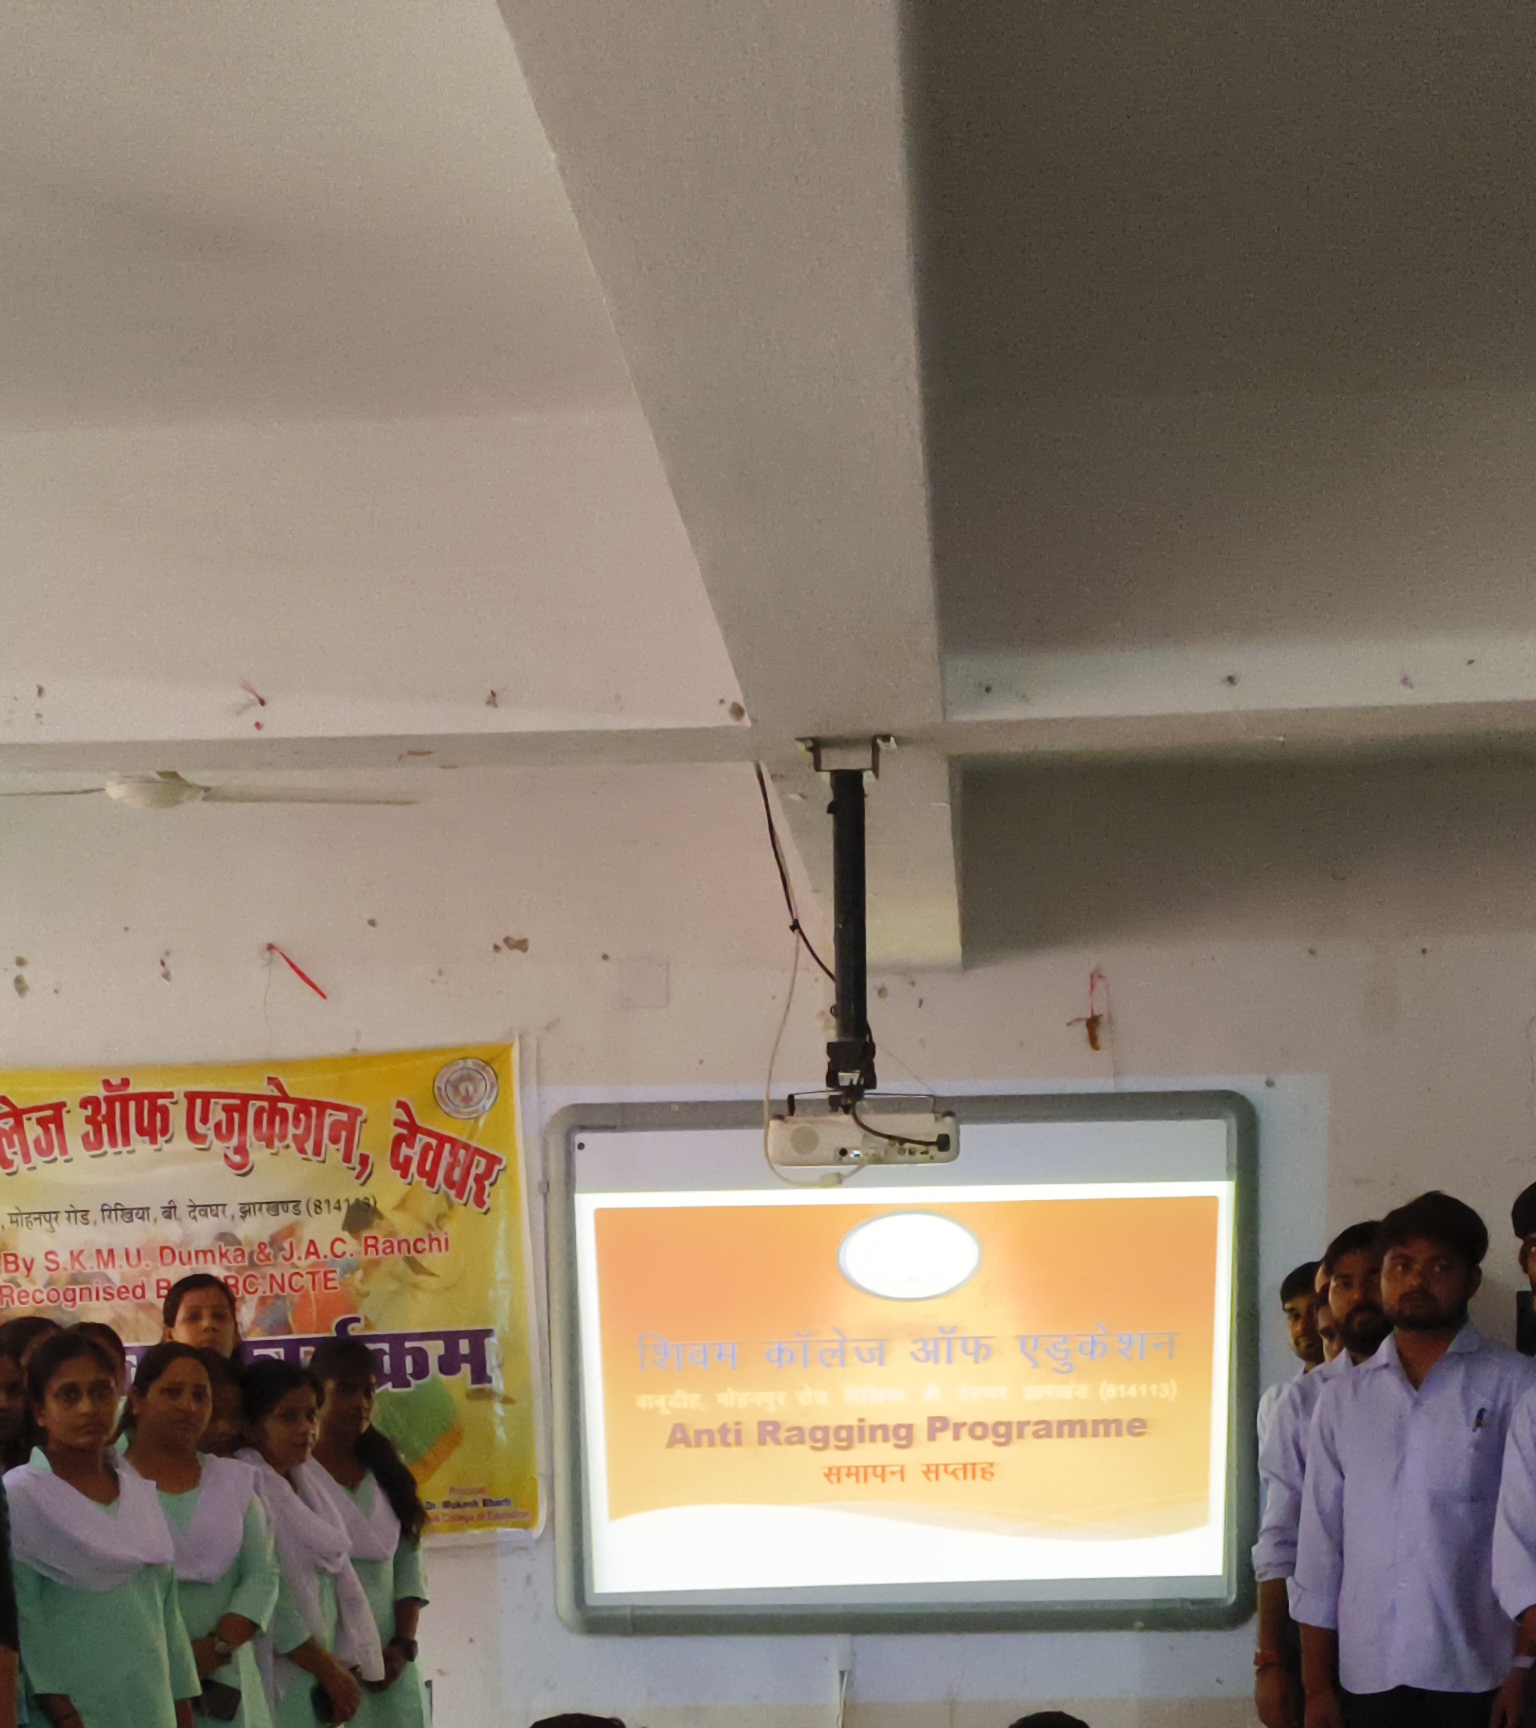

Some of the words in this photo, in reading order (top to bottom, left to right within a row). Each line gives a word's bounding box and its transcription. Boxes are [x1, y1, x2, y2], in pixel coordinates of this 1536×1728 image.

[79, 1077, 176, 1154] ऑफ
[389, 1100, 505, 1213] देवघर
[2, 1252, 35, 1278] By
[44, 1246, 151, 1274] S.K.M.U.
[159, 1242, 247, 1267] Dumka
[254, 1241, 273, 1264] &
[281, 1237, 355, 1262] J.A.C.
[364, 1233, 450, 1258] Ranchi
[156, 1278, 172, 1299] B
[635, 1331, 739, 1372] शिवम
[764, 1327, 889, 1370] कॉलेज
[910, 1325, 996, 1366] ऑफ
[665, 1421, 743, 1449] Anti
[757, 1417, 914, 1451] Ragging
[926, 1415, 1149, 1447] Programme
[820, 1464, 907, 1485] समापन
[921, 1461, 996, 1482] सप्ताह
